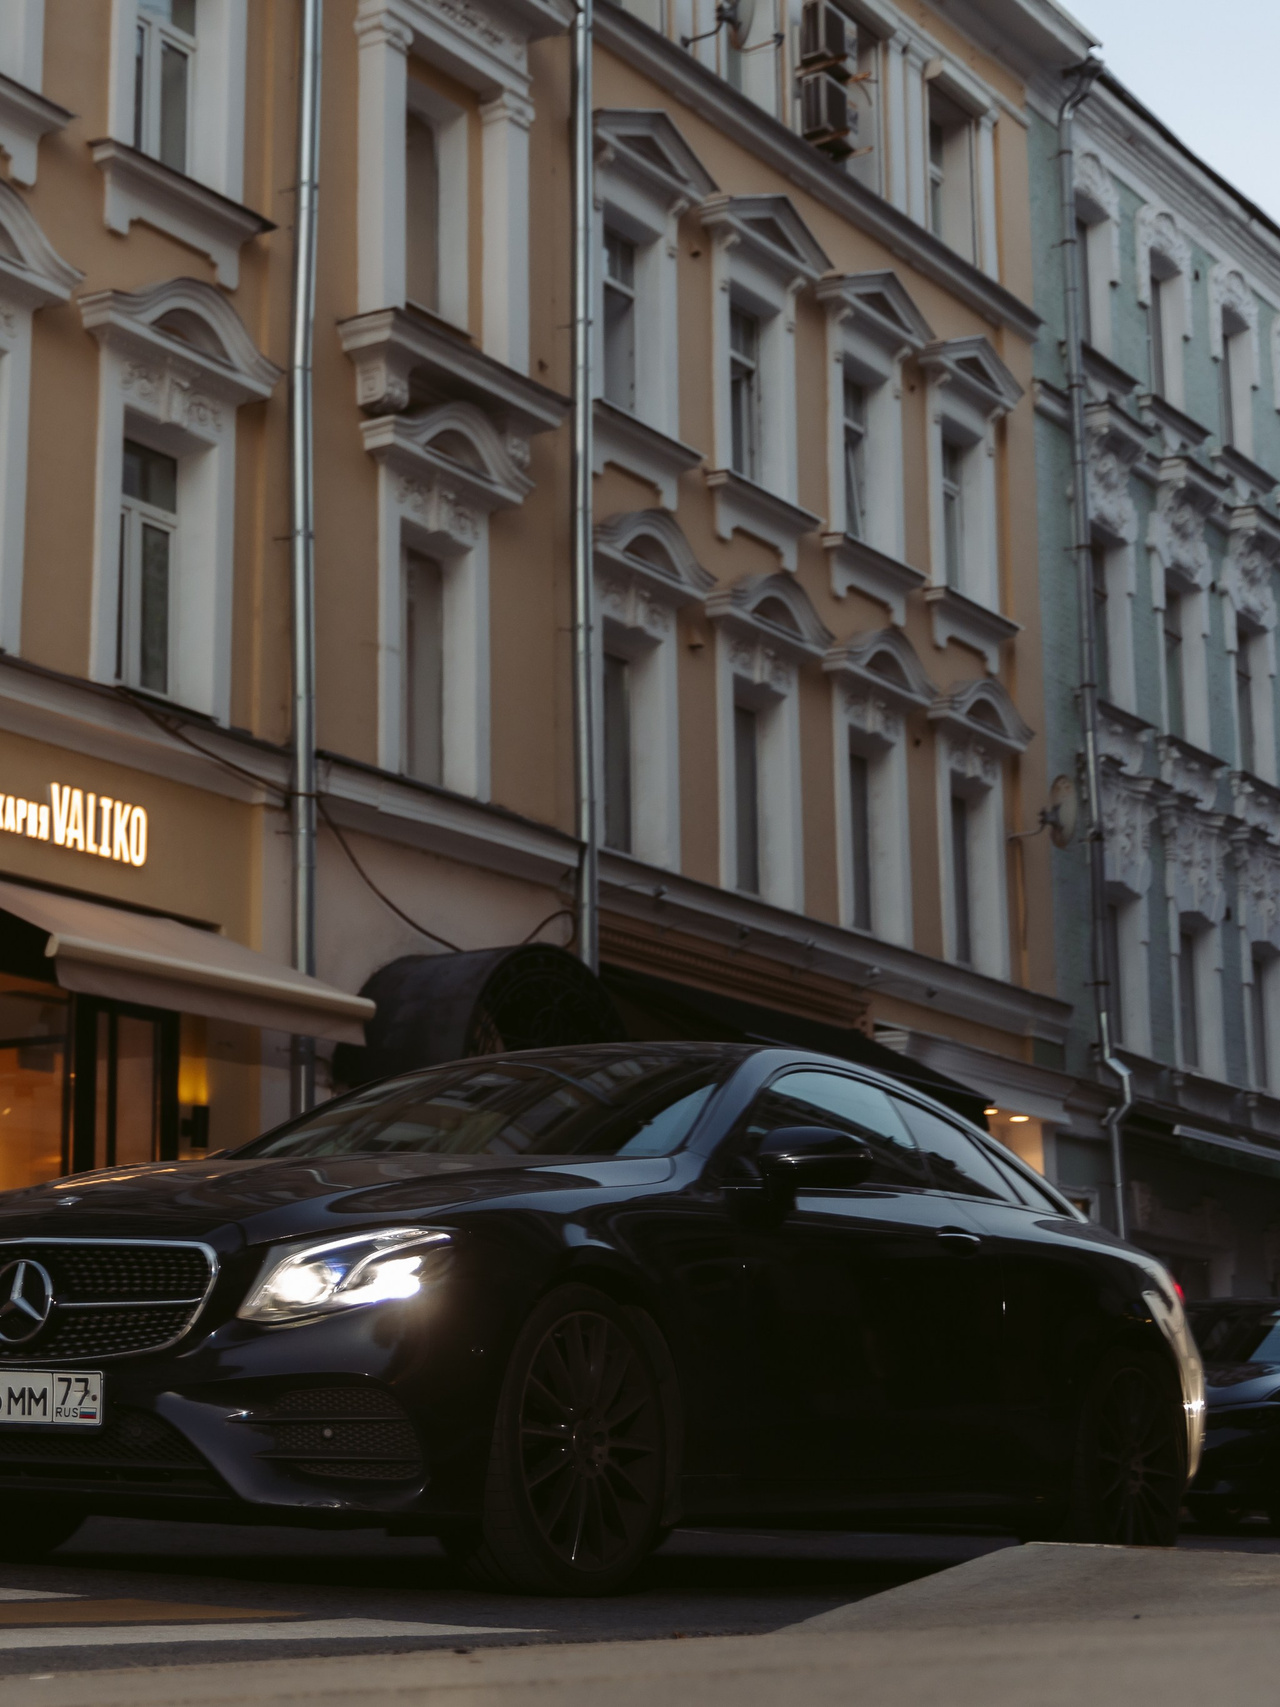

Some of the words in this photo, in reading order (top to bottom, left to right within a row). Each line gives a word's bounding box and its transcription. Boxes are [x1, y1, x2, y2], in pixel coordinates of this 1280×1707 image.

[50, 782, 148, 867] VALIKO
[57, 1377, 90, 1406] 77
[55, 1407, 78, 1418] RUS
